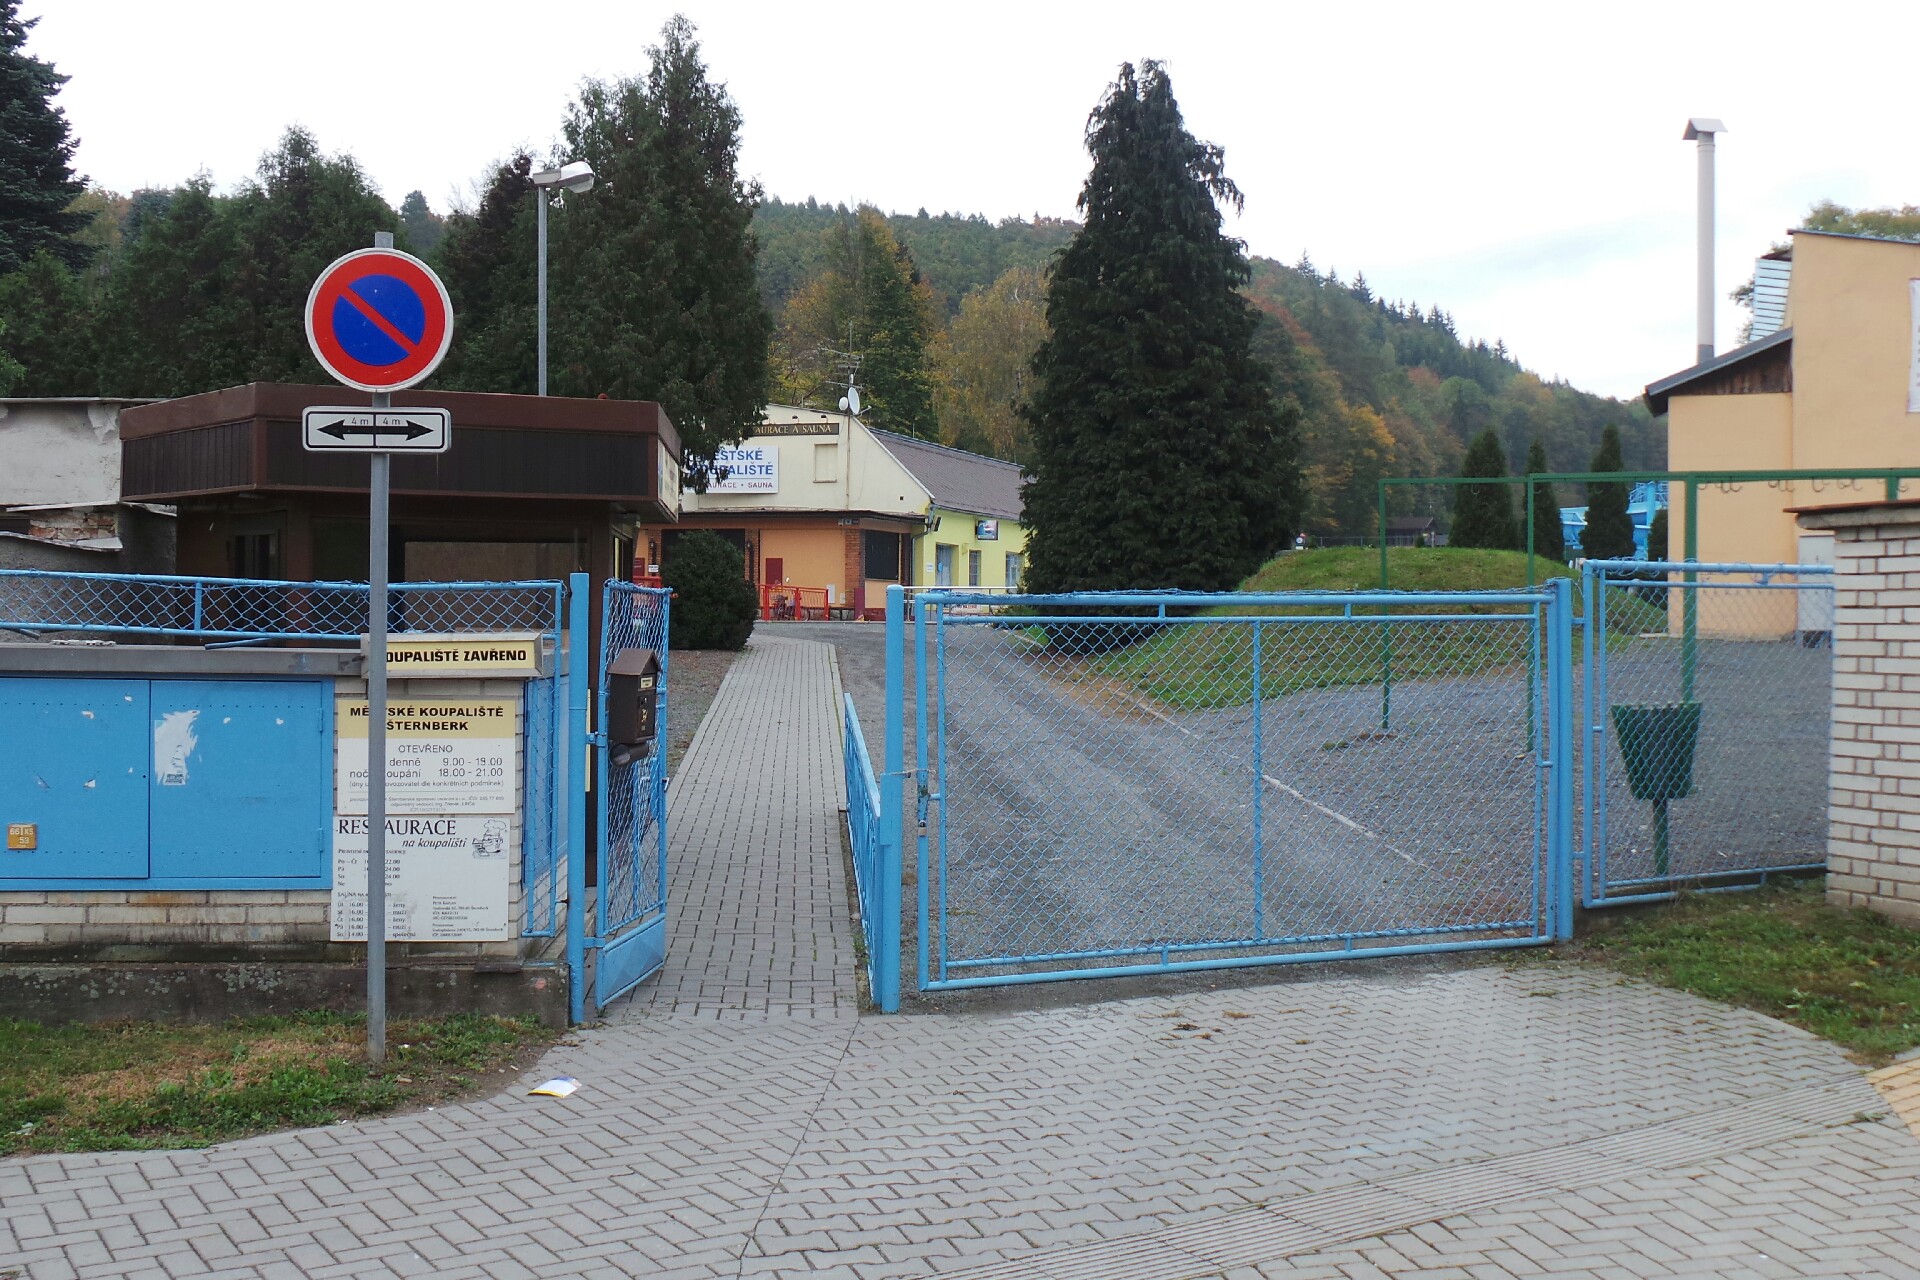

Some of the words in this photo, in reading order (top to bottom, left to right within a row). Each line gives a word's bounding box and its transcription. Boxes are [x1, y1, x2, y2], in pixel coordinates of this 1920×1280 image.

[351, 417, 357, 425] 4
[382, 417, 388, 425] 4
[793, 425, 799, 433] A
[802, 424, 832, 433] SAUNA
[386, 649, 460, 663] OUPALIŠTĚ
[463, 648, 527, 661] ZAVŘENO
[350, 705, 415, 717] MĚSKÉ
[419, 705, 504, 717] KOUPALIŠTĚ
[386, 719, 469, 731] ŠTERNBERK
[398, 744, 453, 753] OTEVŘENO
[389, 757, 421, 767] denně
[442, 757, 465, 767] 9.00
[386, 769, 421, 779] oupání
[438, 768, 465, 777] 18.00
[475, 768, 503, 777] 21.00
[339, 819, 457, 835] RESAURACE
[401, 839, 415, 847] na
[417, 837, 467, 849] koupališti
